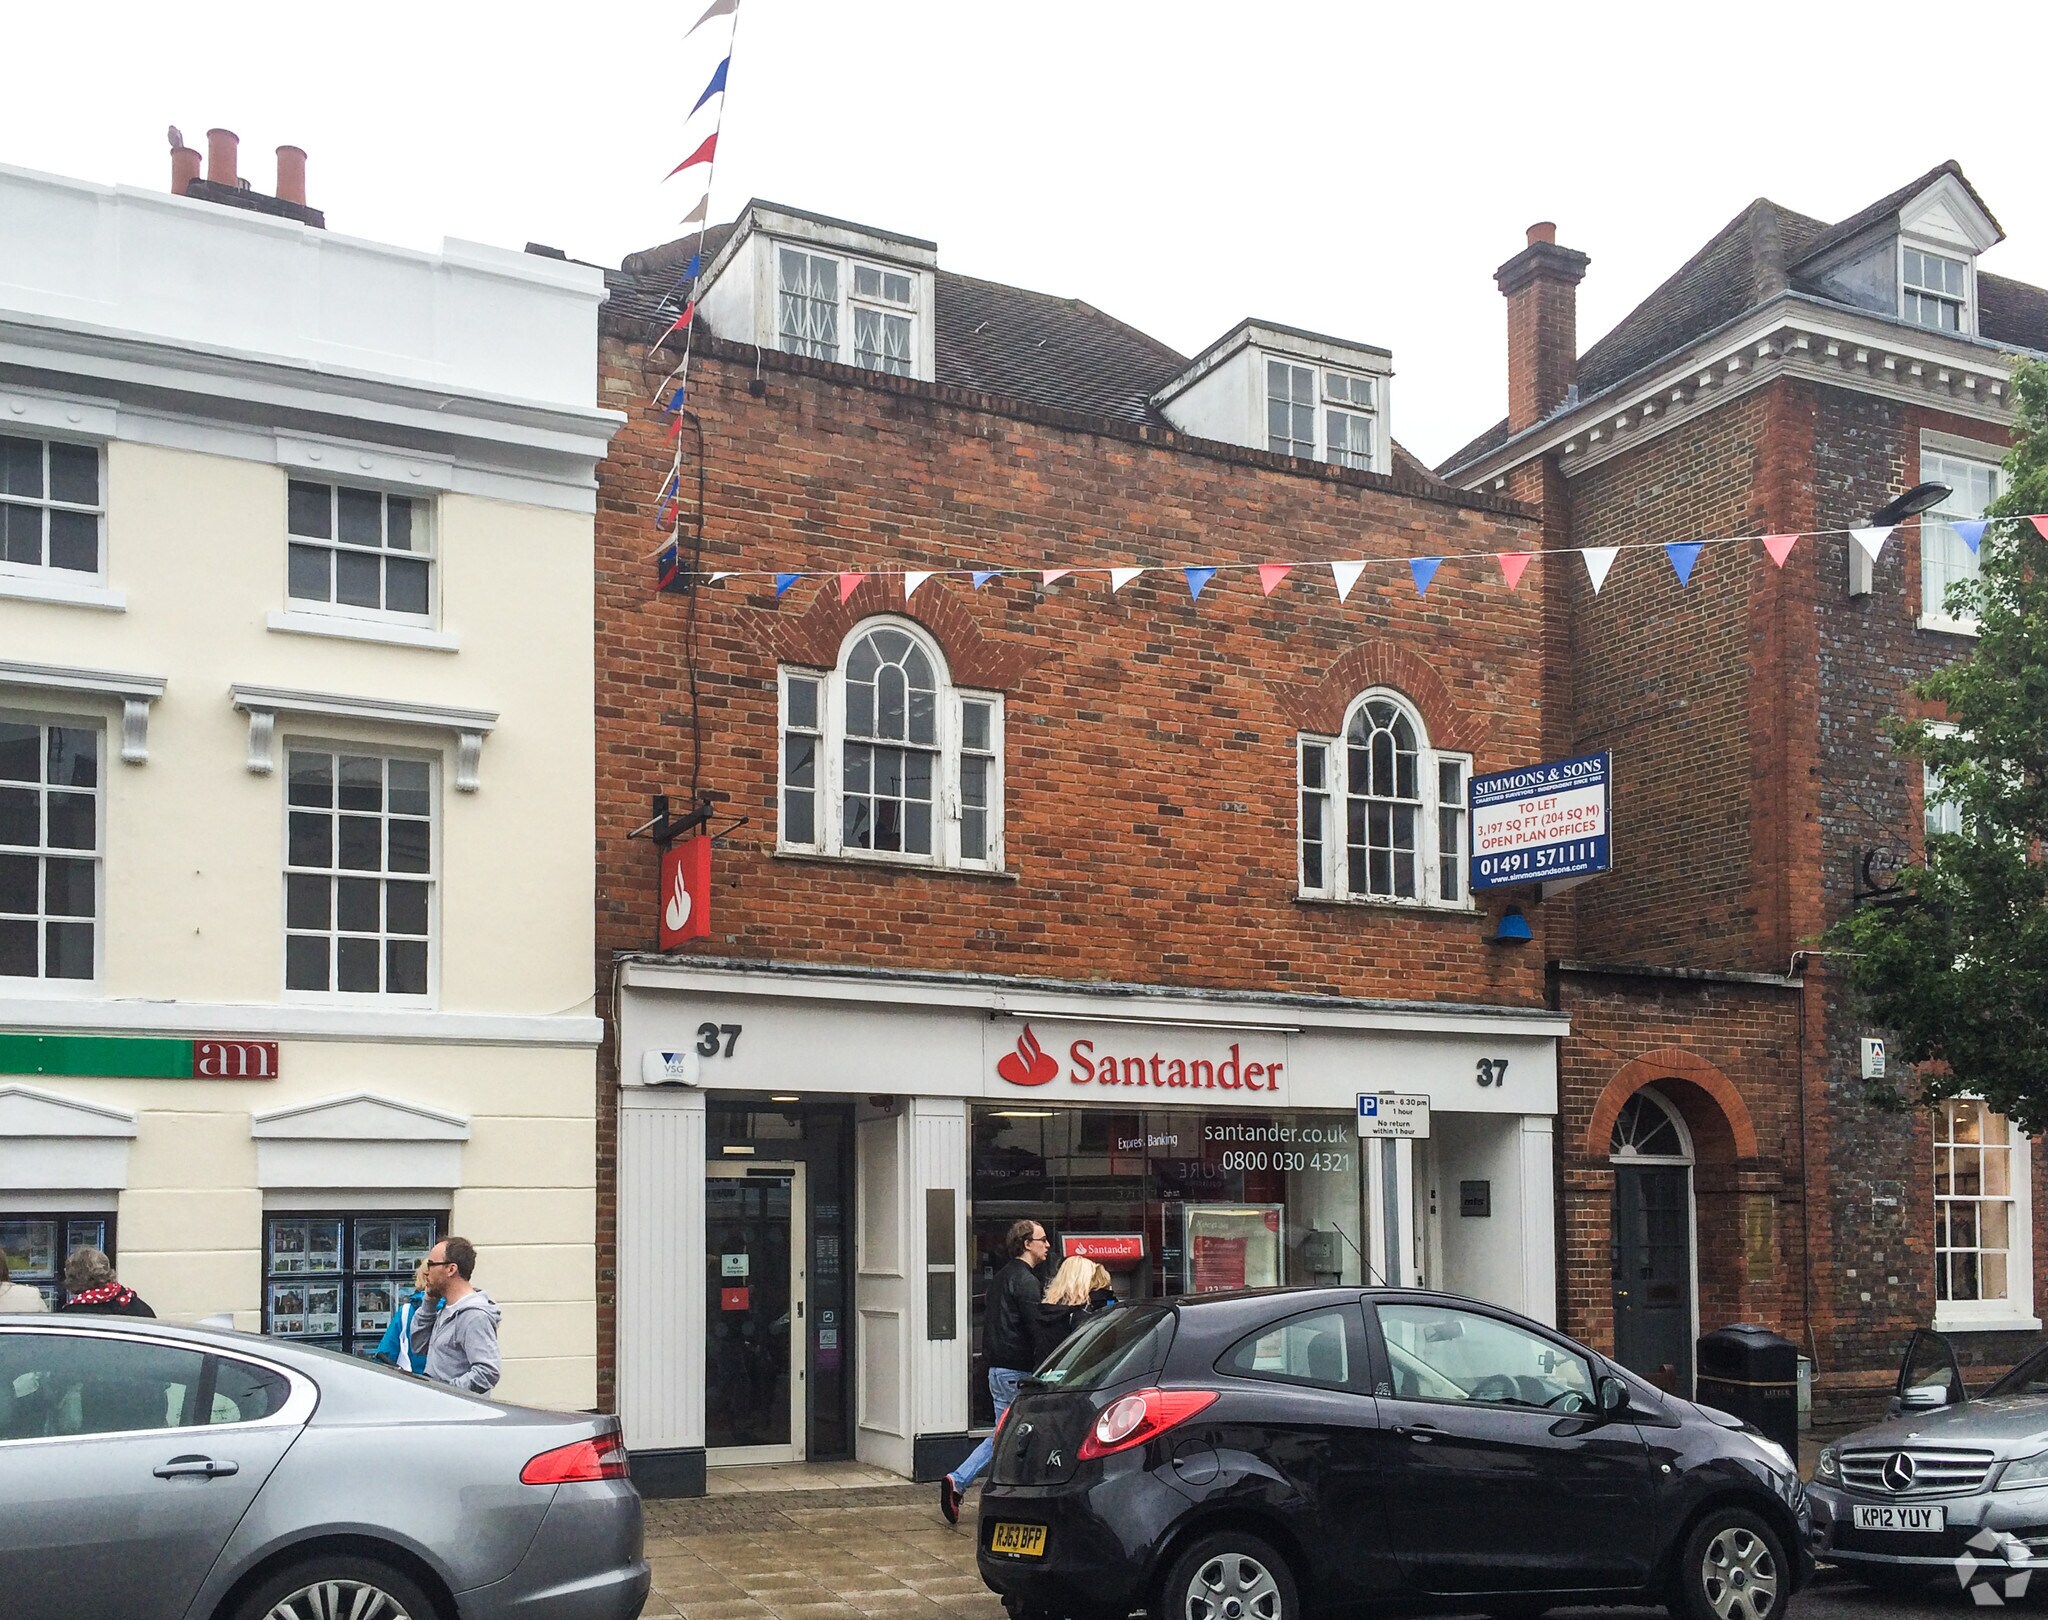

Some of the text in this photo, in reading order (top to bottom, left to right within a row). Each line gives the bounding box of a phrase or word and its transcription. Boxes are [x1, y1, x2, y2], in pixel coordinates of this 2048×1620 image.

[1475, 759, 1602, 795] SIMMONS & SONS
[1475, 793, 1504, 804] CHARTERED
[1505, 788, 1534, 798] SURVEYORS
[1537, 781, 1573, 793] INDEPENDENT
[1518, 798, 1558, 814] TO LET
[1478, 804, 1600, 837] 3,197 SQ FT (204 SQ M)
[1481, 820, 1596, 849] OPEN PLAN OFFICES
[1480, 841, 1595, 876] 01491 571111
[1490, 863, 1588, 884] www.simmonsandsons.com
[696, 1022, 743, 1058] 37
[199, 1043, 271, 1076] am
[664, 1065, 684, 1074] VSG
[1069, 1039, 1284, 1091] Santander
[1476, 1058, 1509, 1087] 37
[1363, 1098, 1375, 1115] P
[1147, 1131, 1178, 1148] Banking
[1204, 1122, 1348, 1143] santander.co.uk
[1222, 1151, 1350, 1172] 0800 030 4321
[1088, 1244, 1132, 1254] Santander
[1862, 1508, 1931, 1528] KP12 YUY
[996, 1526, 1042, 1549] RJ63 BFP
